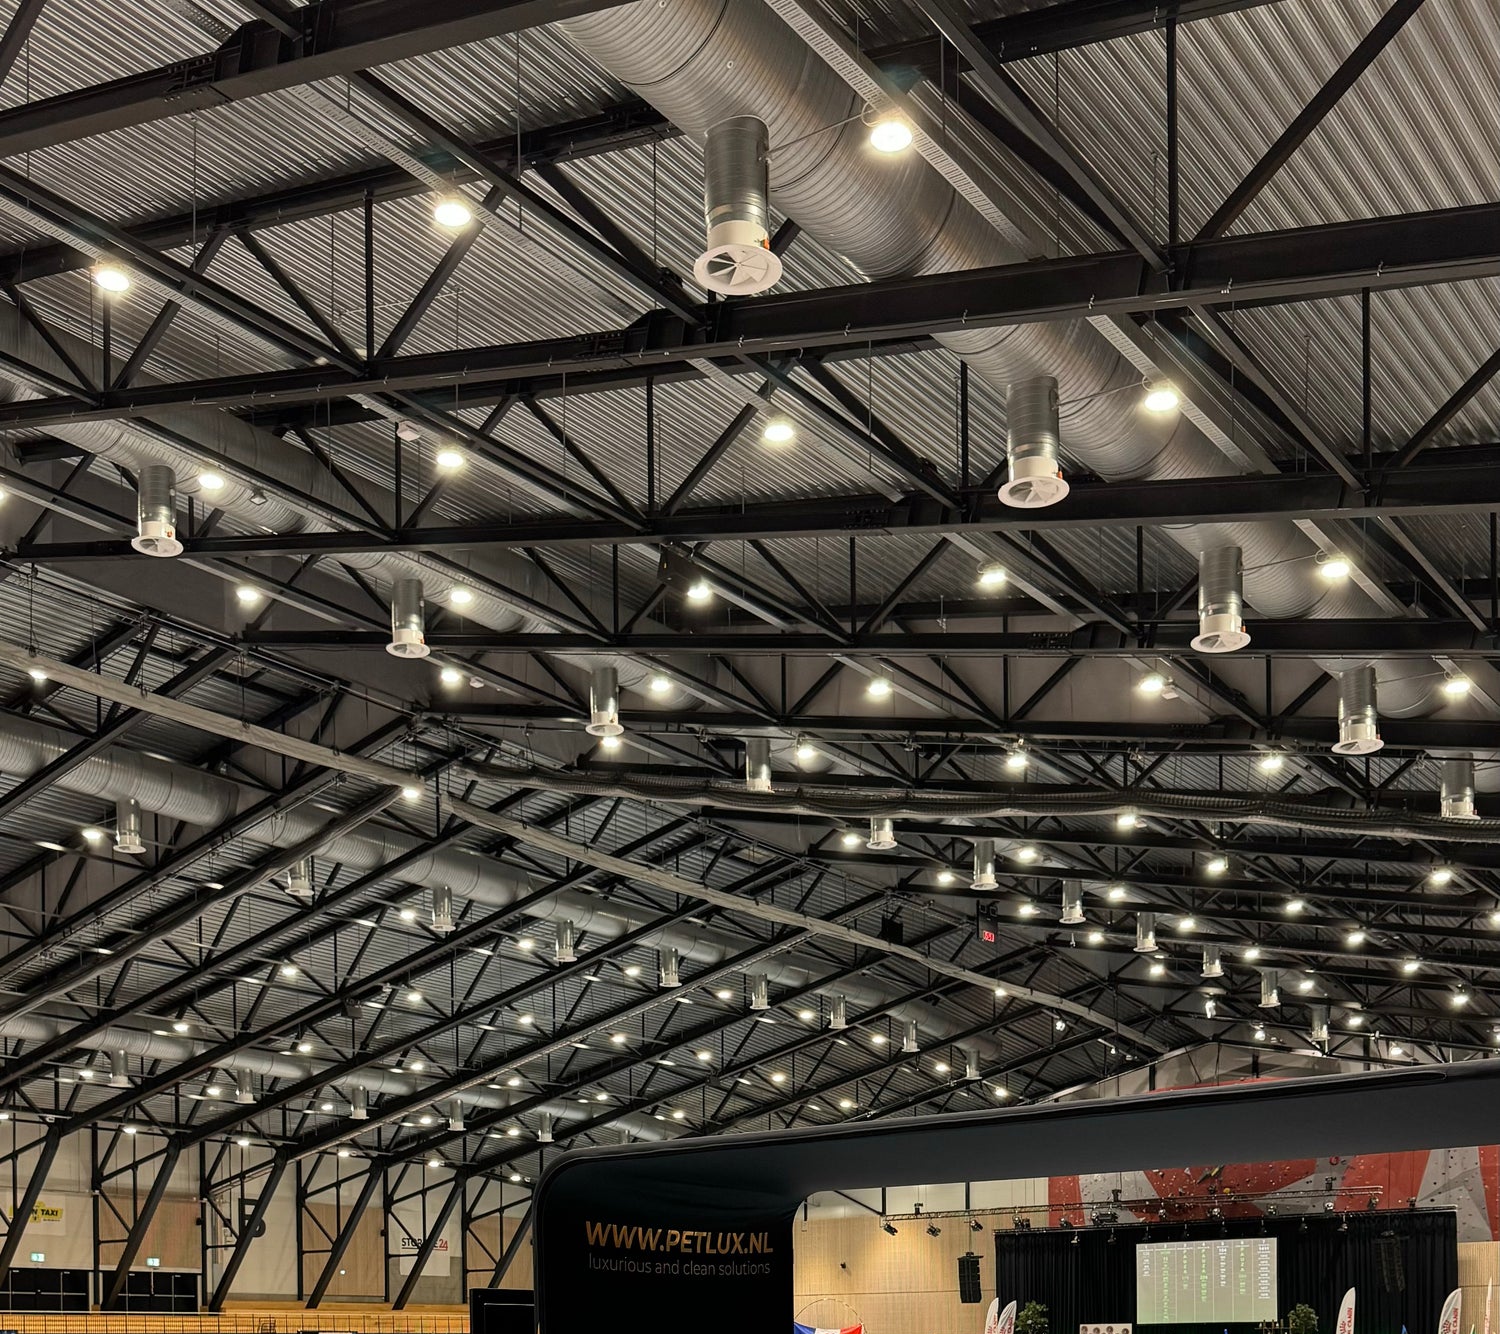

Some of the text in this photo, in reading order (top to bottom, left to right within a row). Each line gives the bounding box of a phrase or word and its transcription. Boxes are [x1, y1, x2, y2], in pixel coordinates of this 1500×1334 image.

[41, 1208, 59, 1217] TAXI
[586, 1221, 774, 1255] WWW.PETLUX.NL
[589, 1252, 771, 1276] luxurious and clean solutions
